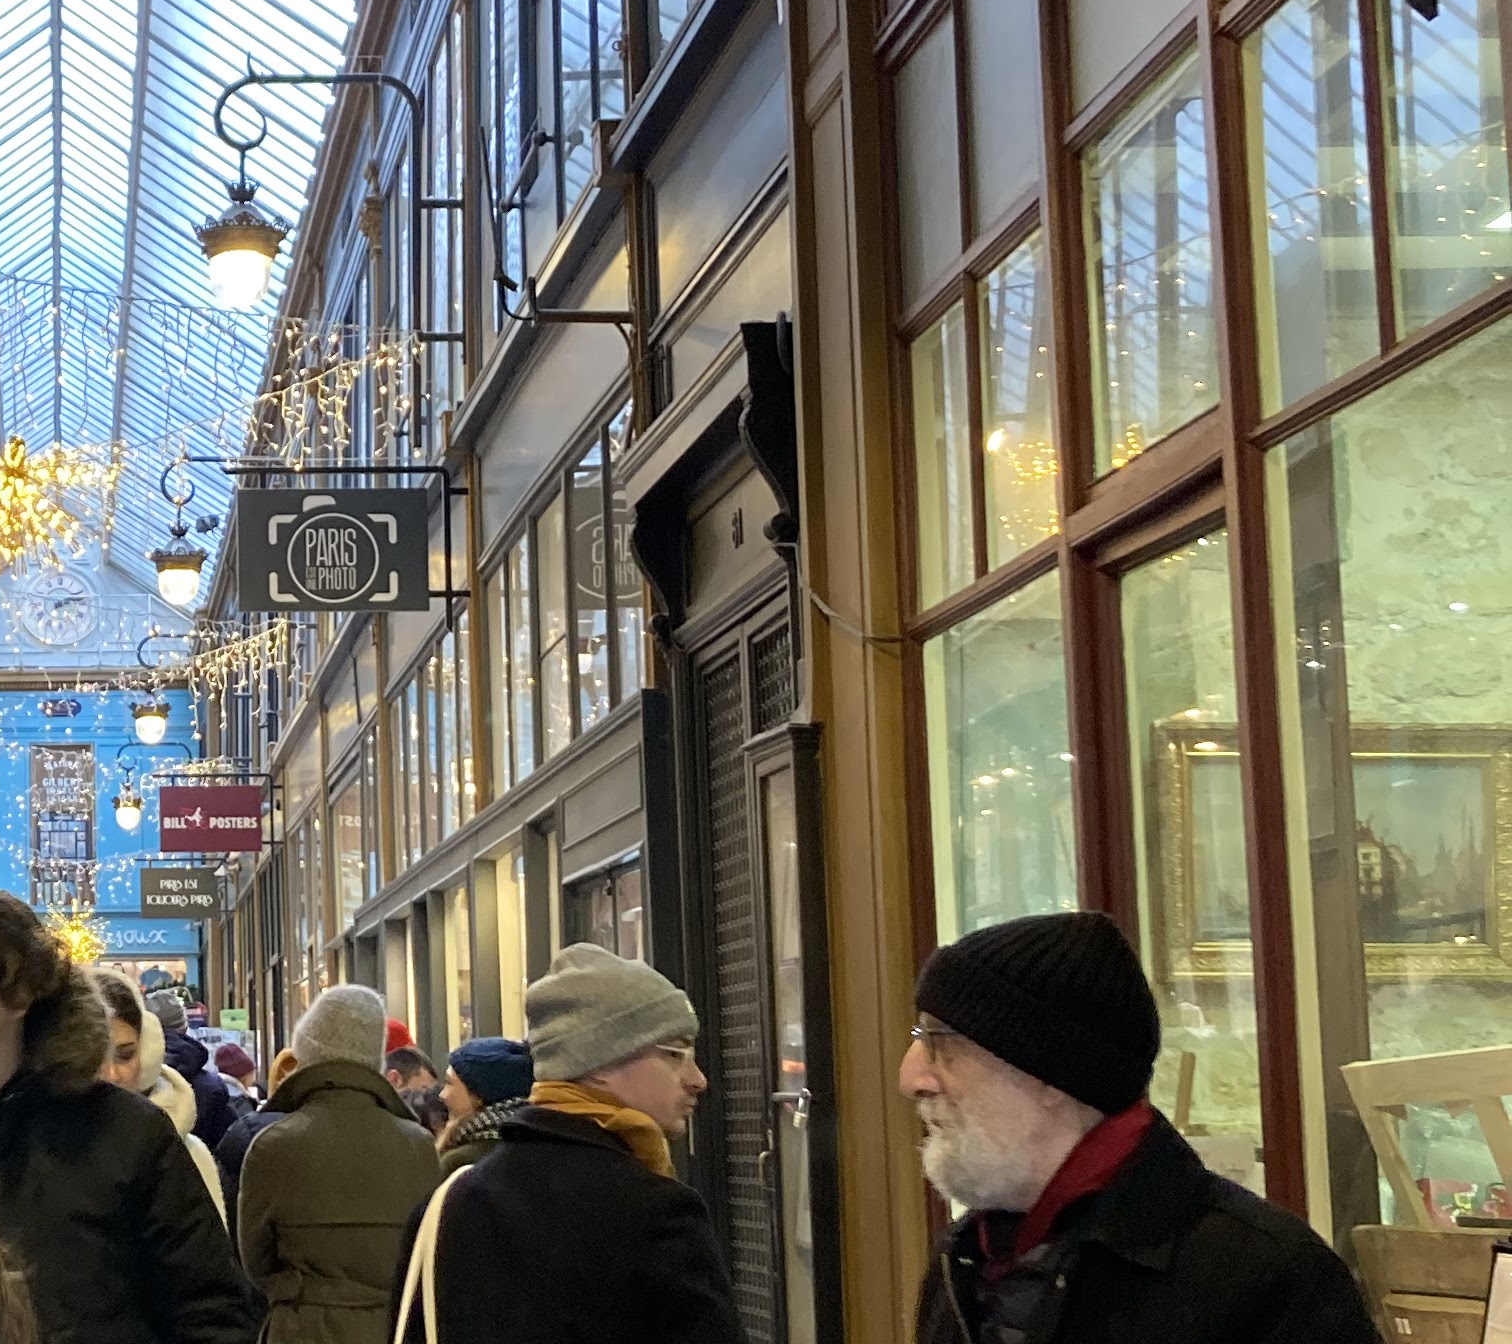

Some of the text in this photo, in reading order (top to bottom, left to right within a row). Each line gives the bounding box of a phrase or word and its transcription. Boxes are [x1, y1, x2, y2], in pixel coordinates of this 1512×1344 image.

[305, 528, 357, 567] PARIS
[318, 567, 357, 591] PHOTO
[163, 816, 258, 829] BILL POSTERS
